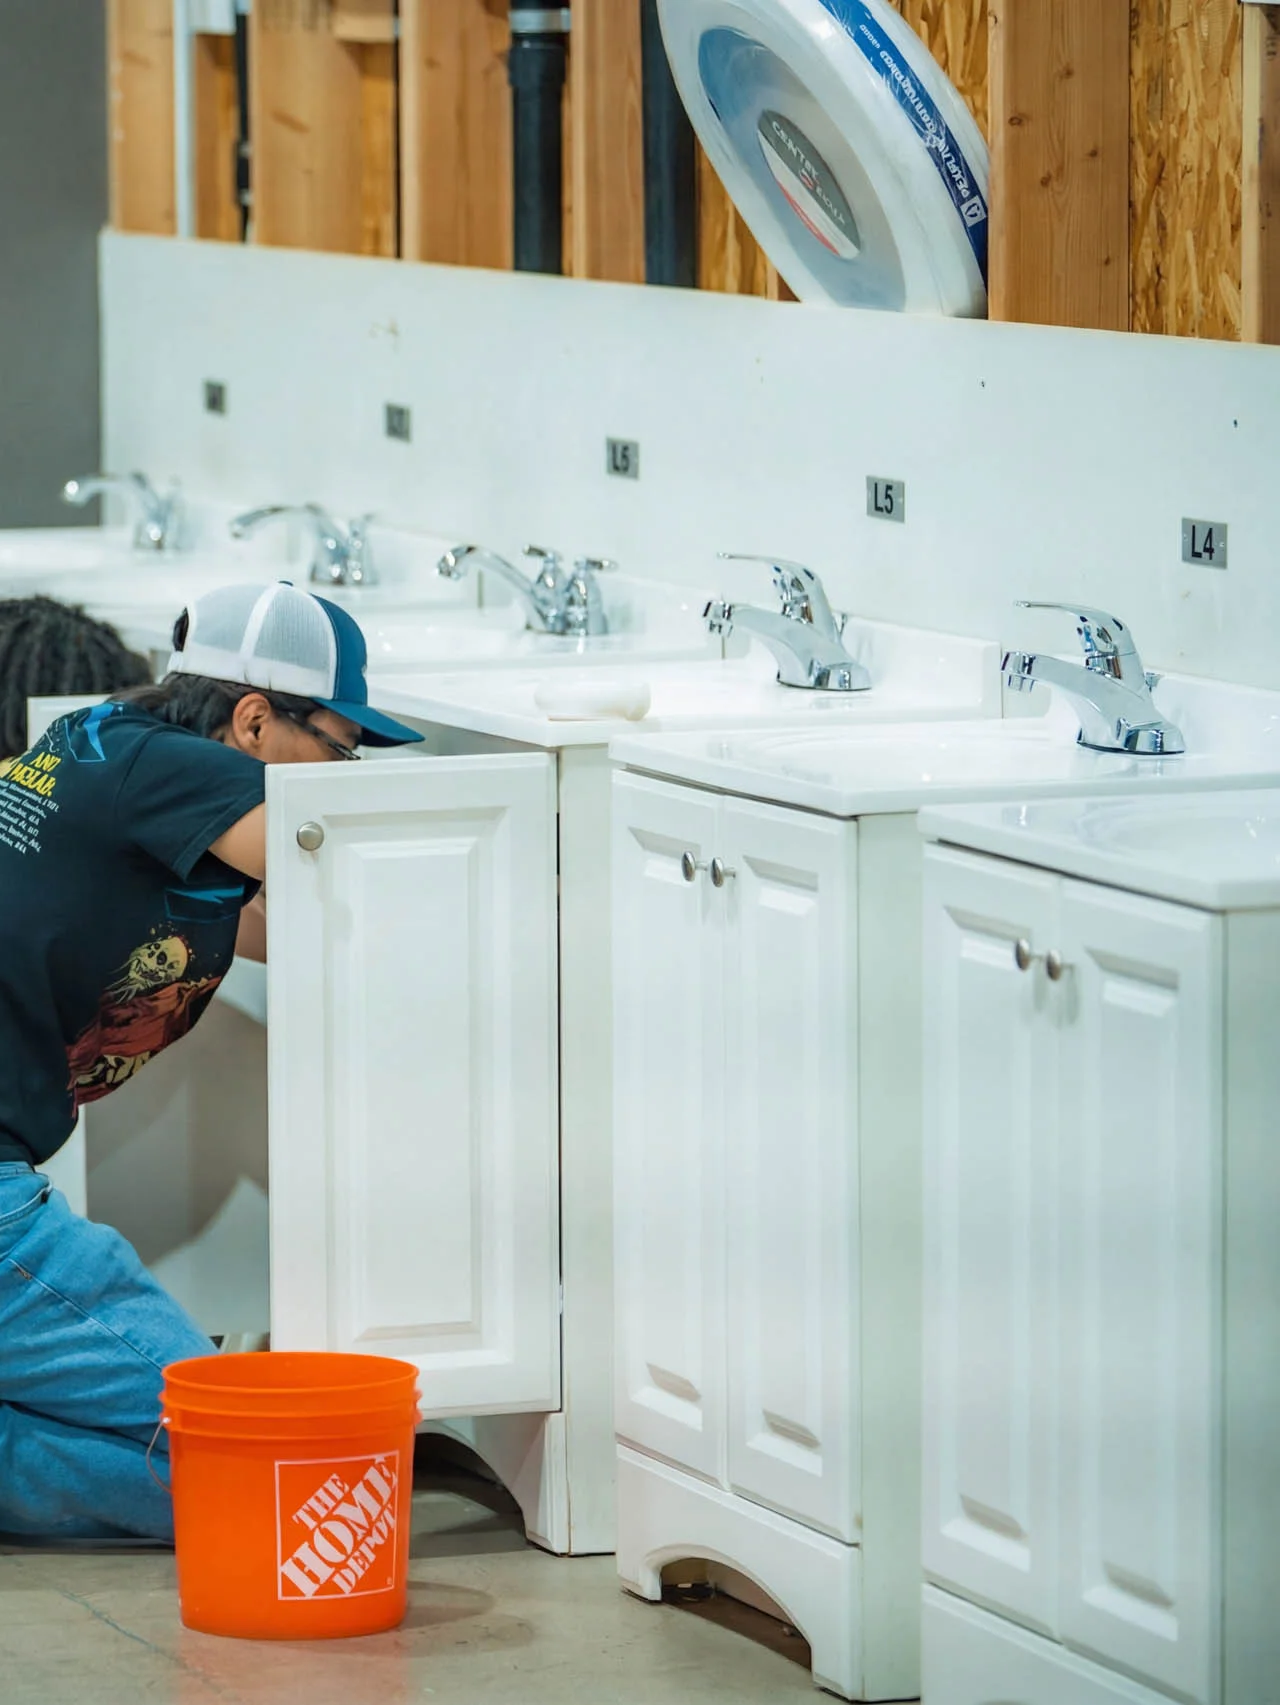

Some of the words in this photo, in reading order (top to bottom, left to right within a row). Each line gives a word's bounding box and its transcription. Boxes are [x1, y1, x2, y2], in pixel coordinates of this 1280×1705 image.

[873, 482, 894, 514] L5
[1191, 525, 1215, 561] L4
[279, 1455, 398, 1598] HOME
[291, 1473, 350, 1531] THE
[332, 1503, 396, 1595] DEPOT
